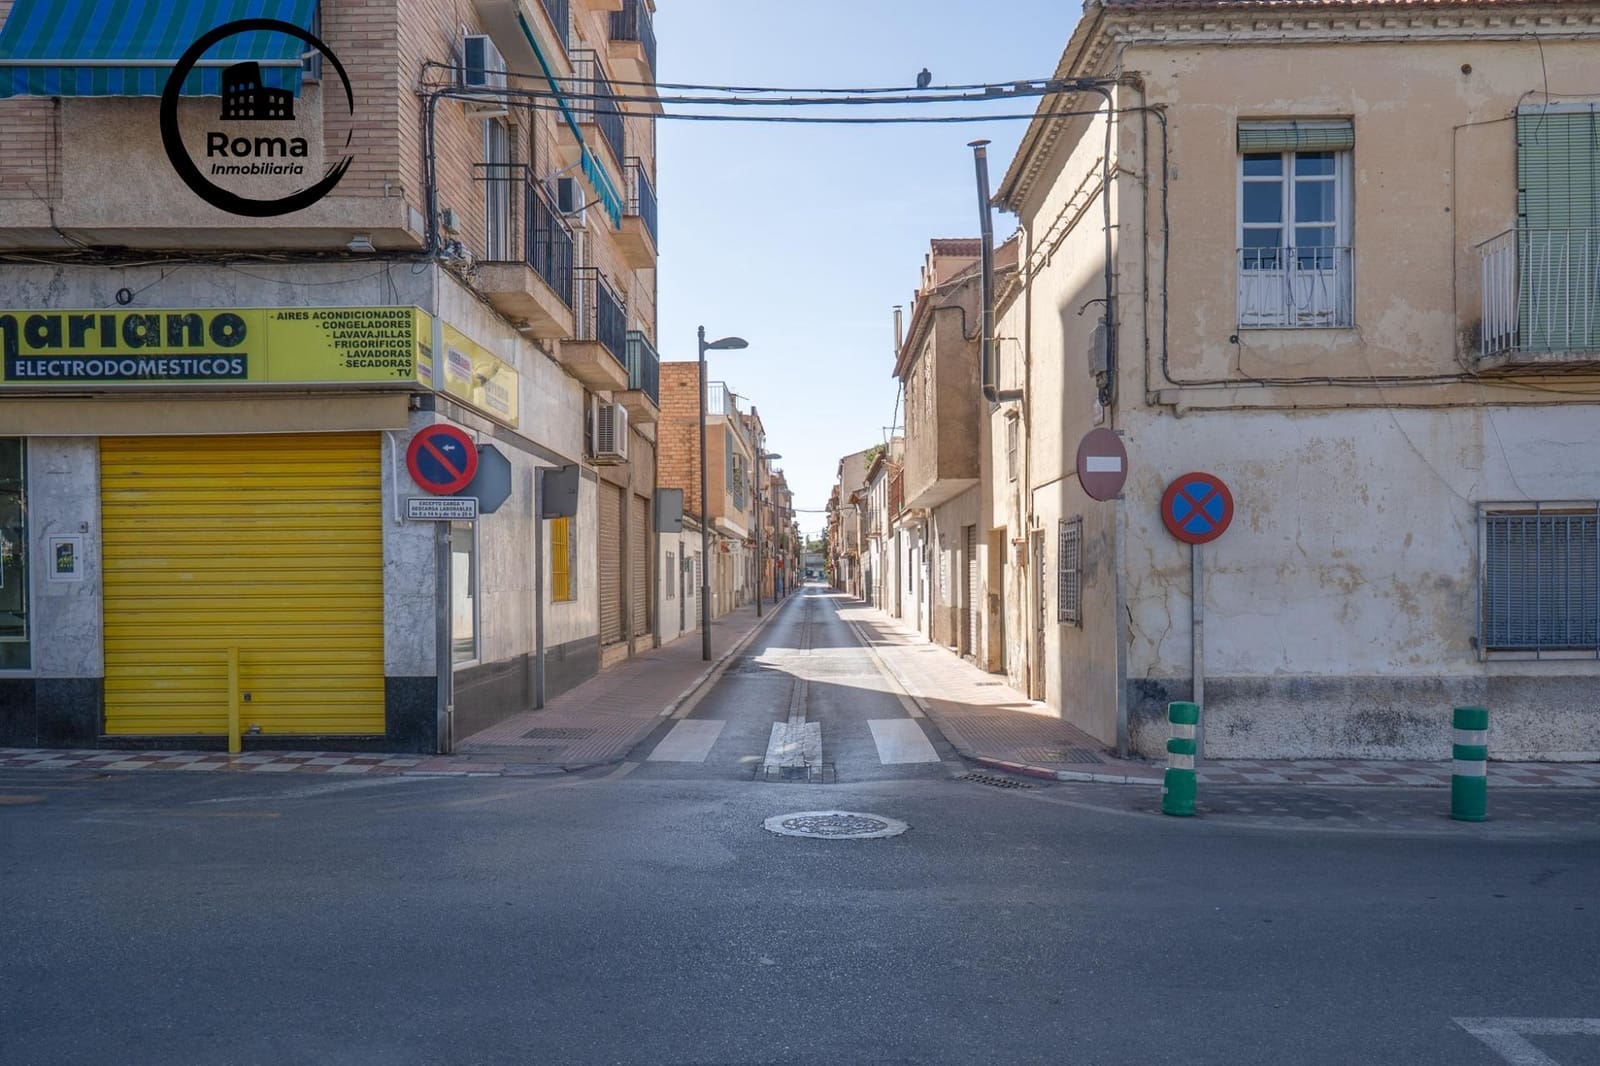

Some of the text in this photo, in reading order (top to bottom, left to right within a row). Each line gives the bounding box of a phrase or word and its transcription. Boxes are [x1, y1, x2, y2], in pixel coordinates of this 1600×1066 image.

[277, 312, 309, 320] AIRES
[312, 311, 411, 320] ACONDICIONADOS
[322, 320, 411, 329] CONGELADORES
[333, 330, 411, 339] LAVAVAJILLAS
[334, 338, 411, 349] FRIGORÍFICOS
[347, 349, 411, 358] LAVADORAS
[15, 358, 243, 377] ELECTRODOMESTICOS
[345, 359, 411, 368] SECADORAS
[397, 368, 411, 377] TV
